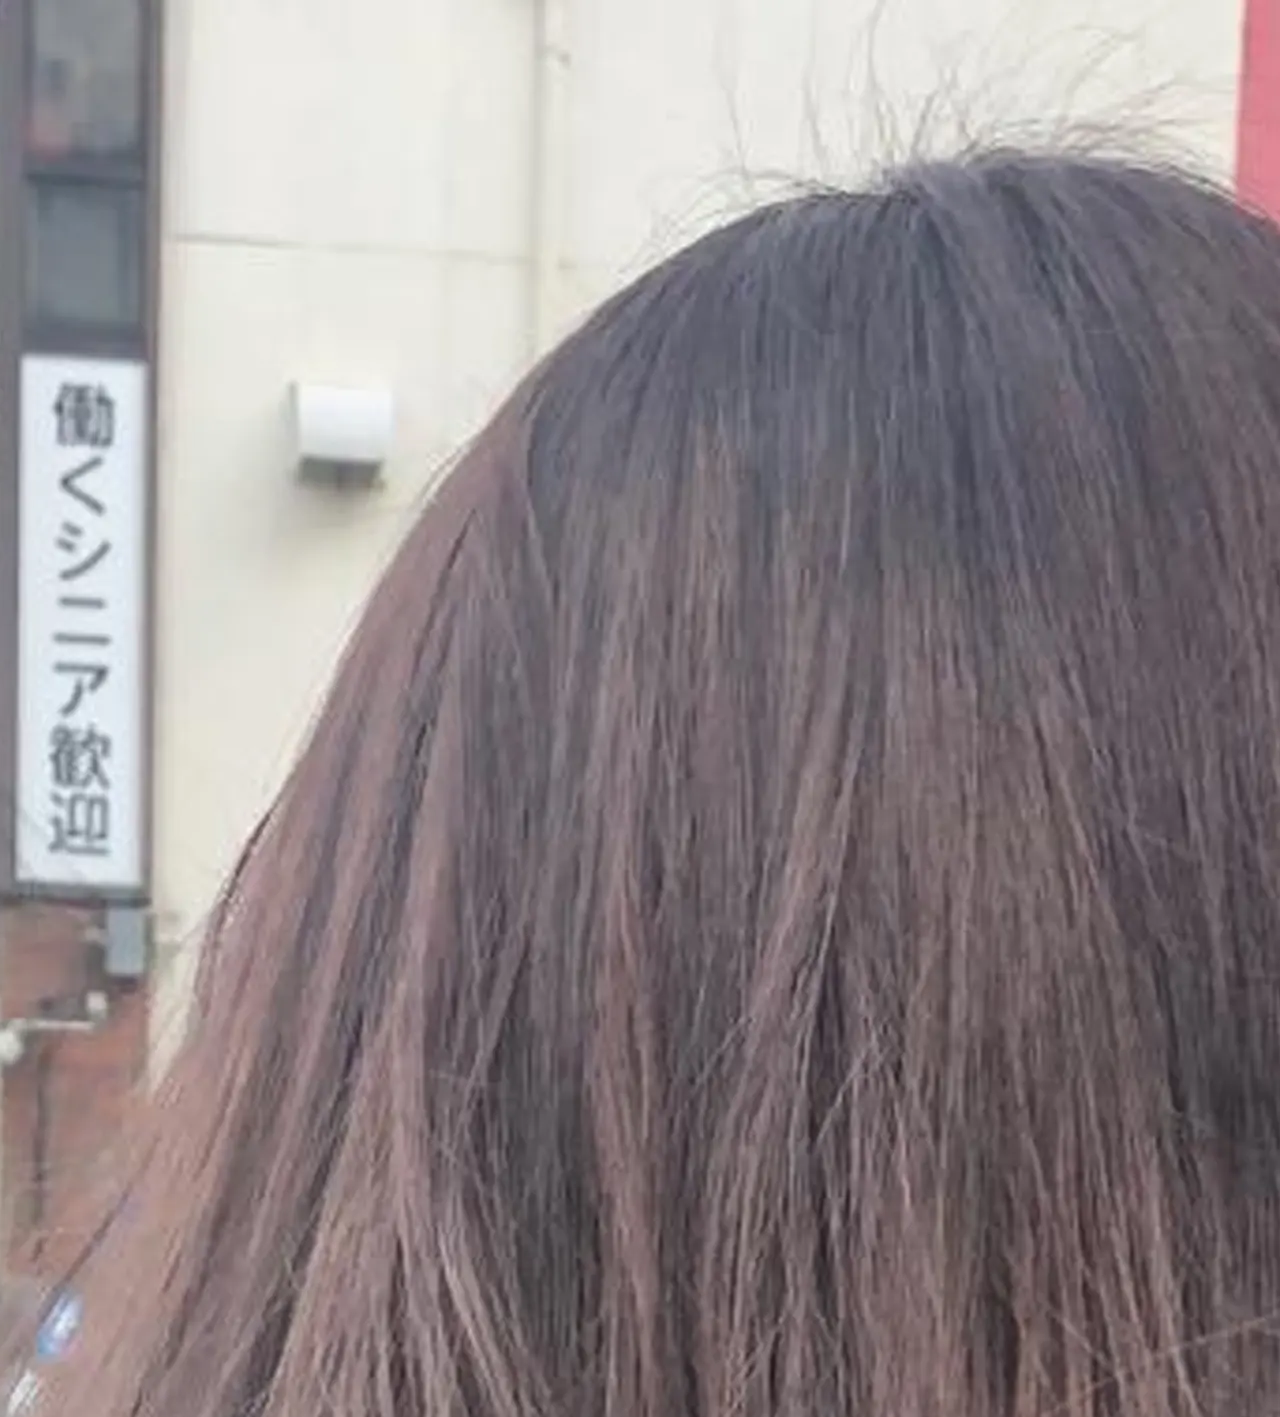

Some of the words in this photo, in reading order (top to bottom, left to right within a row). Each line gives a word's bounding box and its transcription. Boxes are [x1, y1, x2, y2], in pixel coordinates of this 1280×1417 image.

[49, 381, 115, 856] 働くシニア歓迎
